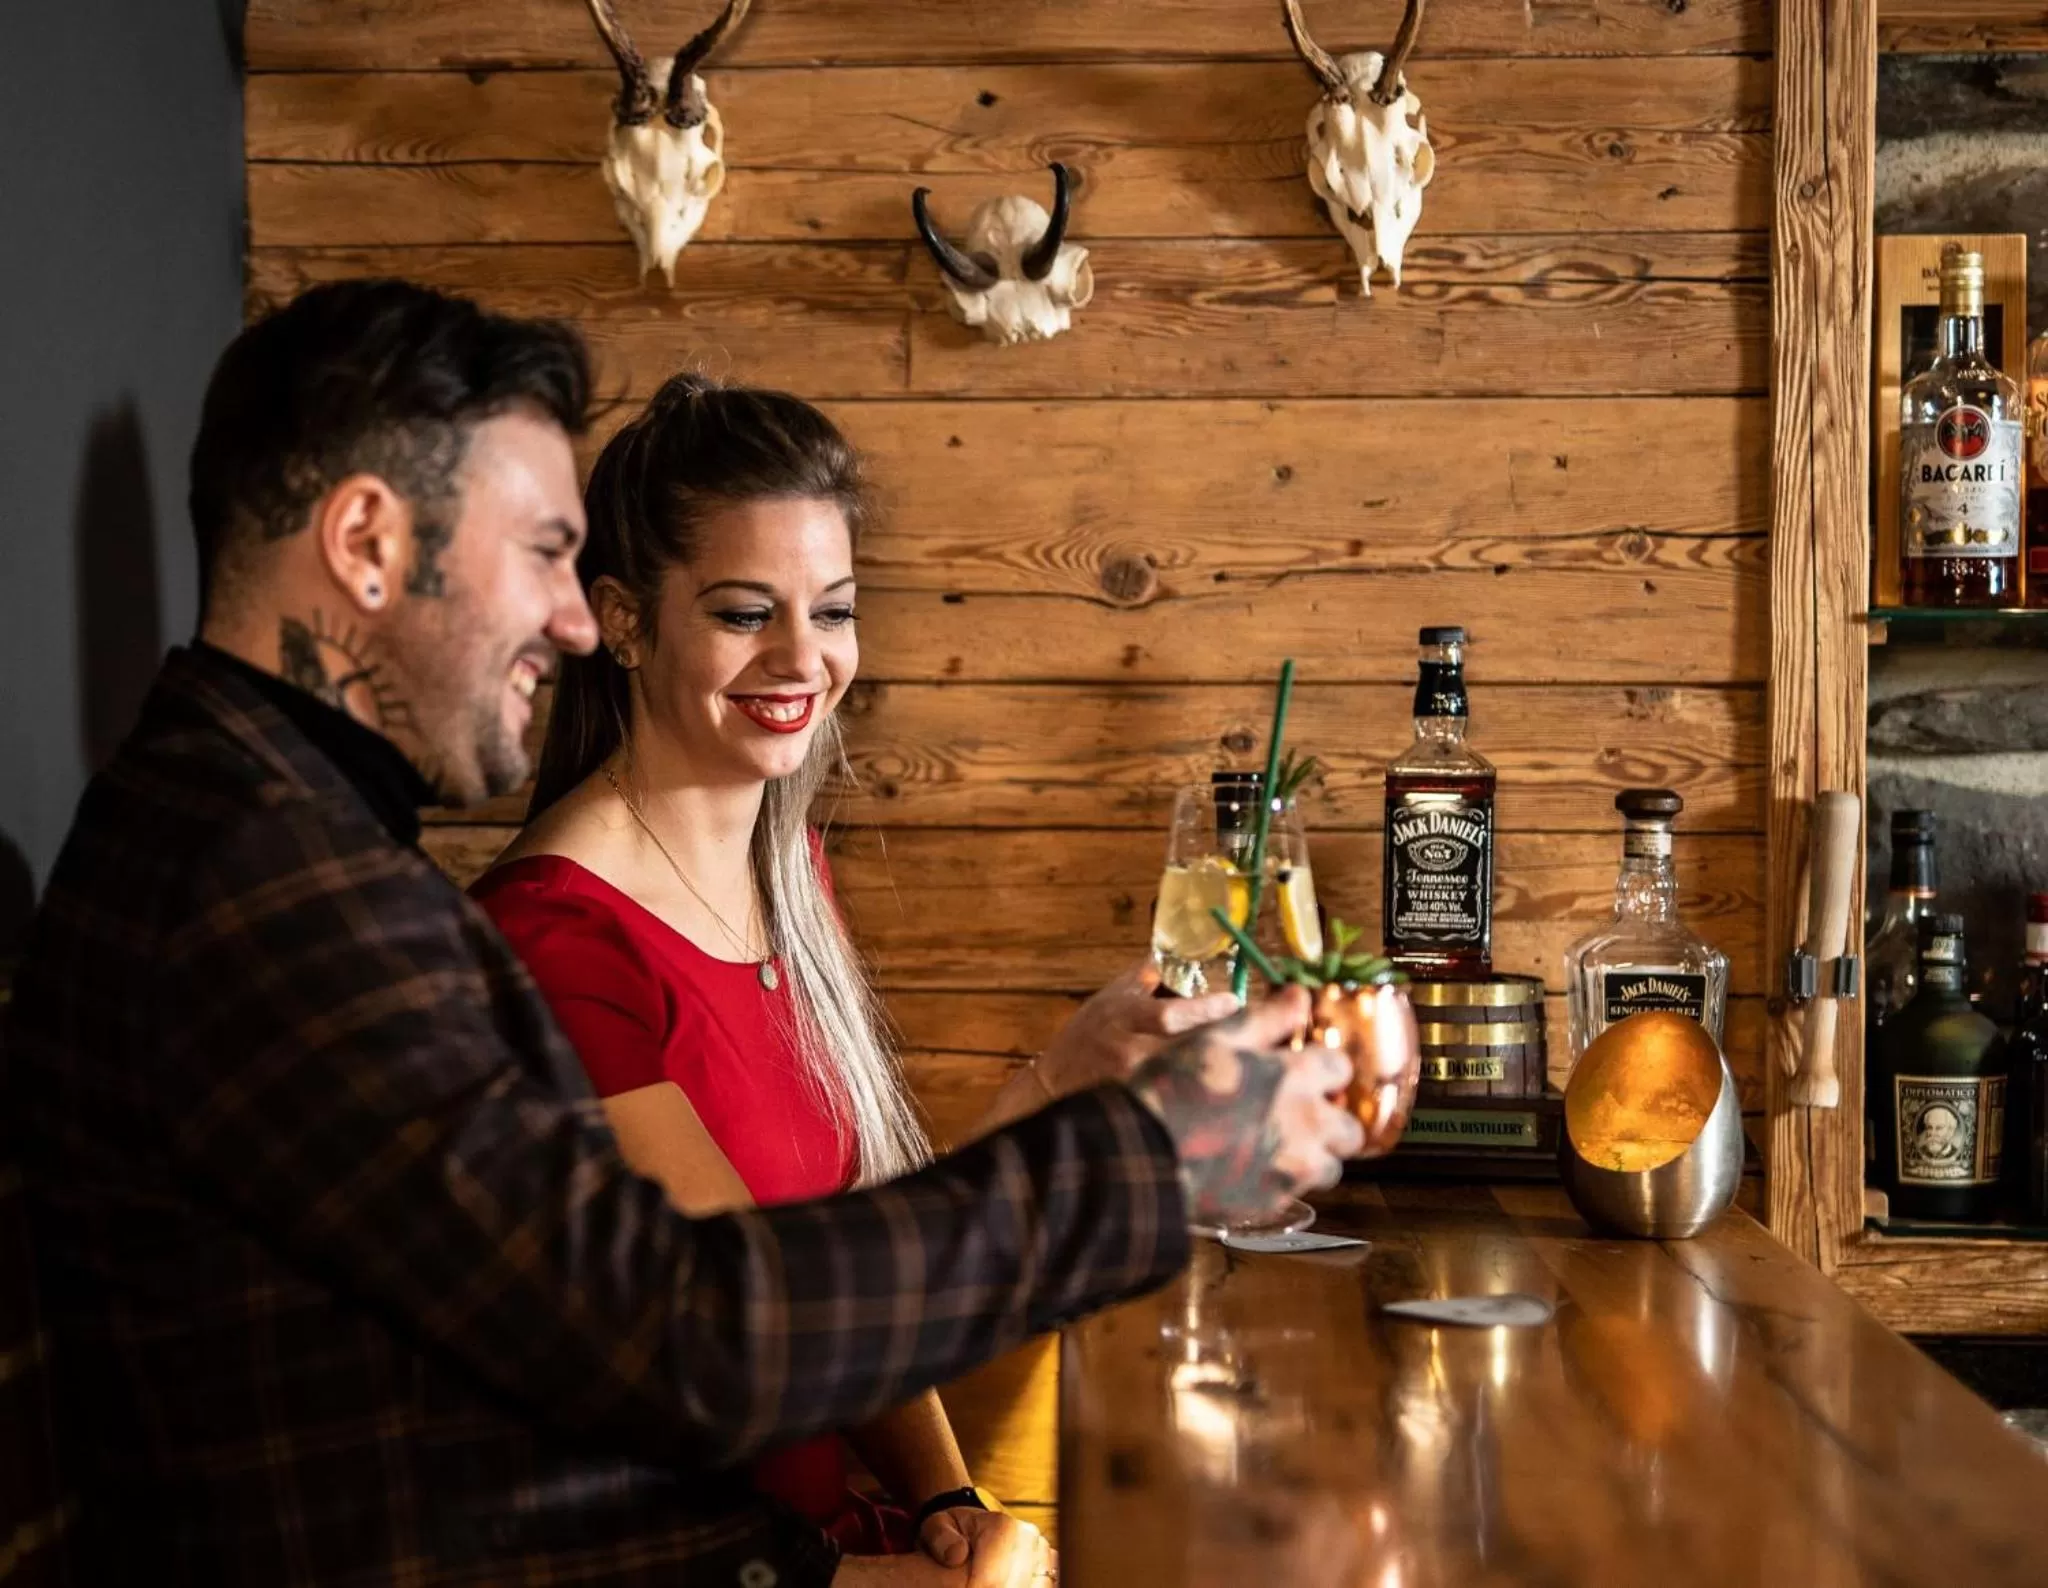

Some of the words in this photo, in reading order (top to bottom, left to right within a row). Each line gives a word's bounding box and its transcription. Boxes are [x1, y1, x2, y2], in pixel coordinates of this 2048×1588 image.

[1392, 817, 1429, 846] JACK
[1430, 811, 1488, 847] DANIEL'S
[1407, 889, 1468, 901] WHISKEY
[1620, 981, 1647, 1001] JACK
[1419, 1062, 1442, 1077] ACK
